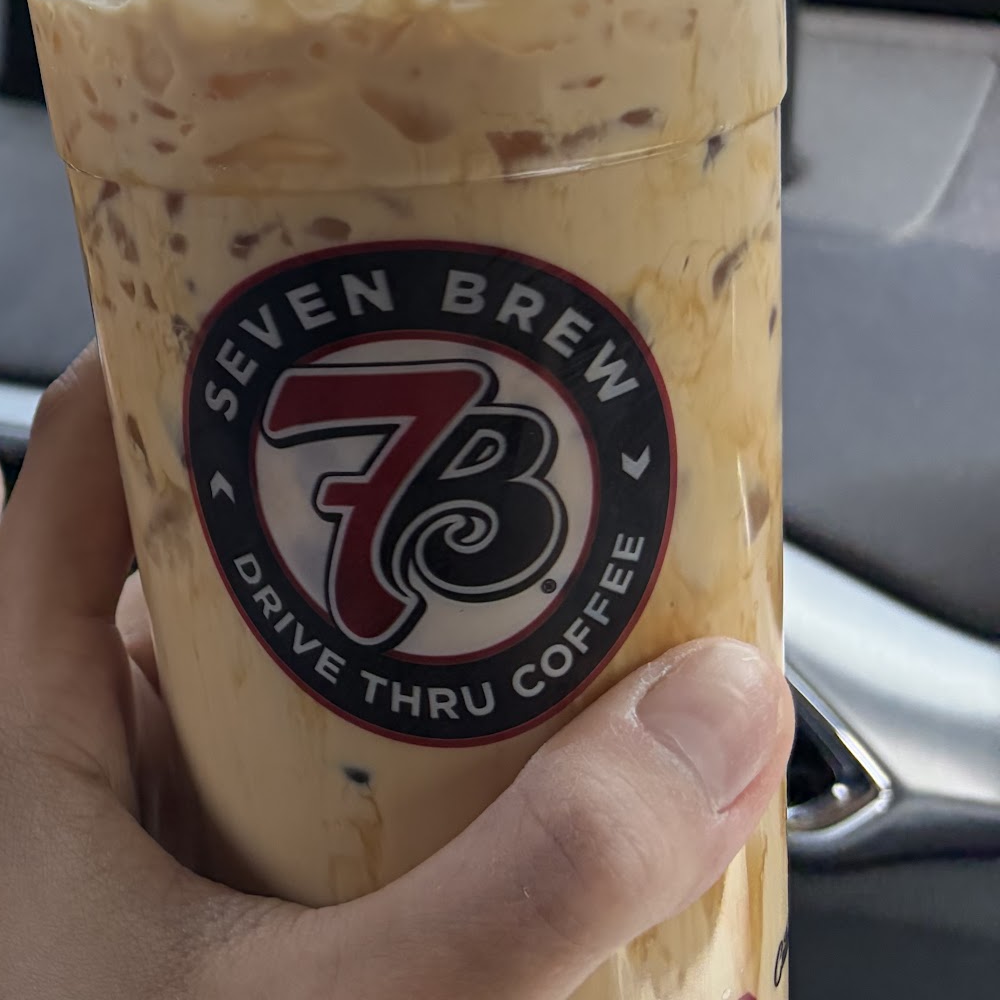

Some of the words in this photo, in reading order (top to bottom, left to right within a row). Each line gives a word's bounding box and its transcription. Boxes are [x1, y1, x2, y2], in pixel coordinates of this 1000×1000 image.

[204, 269, 395, 422] SEVEN
[441, 269, 640, 403] BREW
[233, 552, 347, 686] DRIVE
[360, 670, 496, 721] THRU
[511, 533, 646, 698] COFFEE
